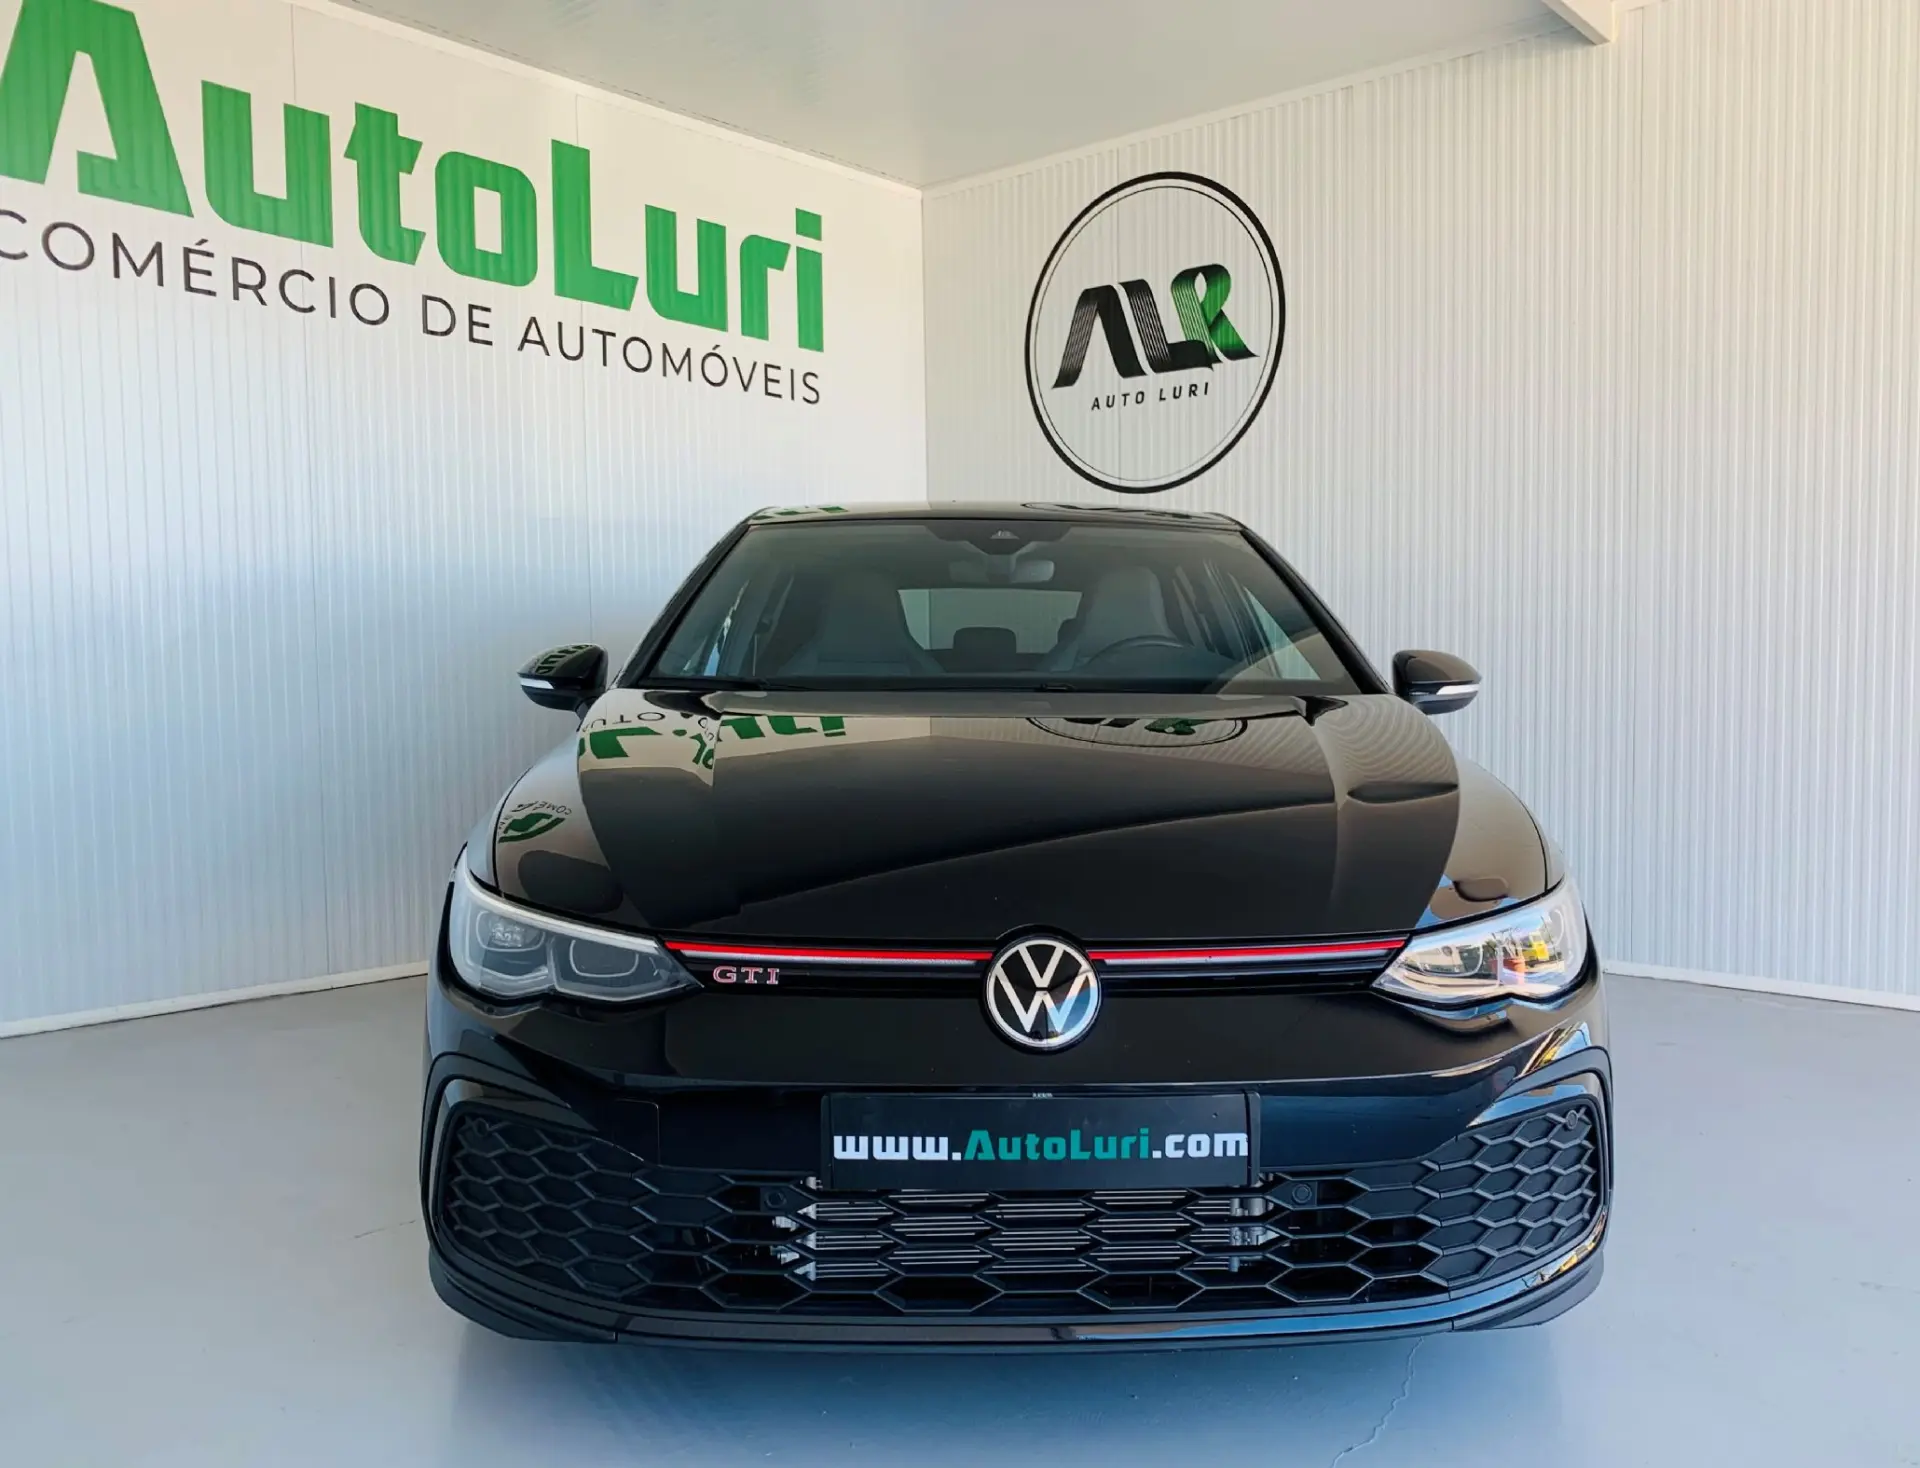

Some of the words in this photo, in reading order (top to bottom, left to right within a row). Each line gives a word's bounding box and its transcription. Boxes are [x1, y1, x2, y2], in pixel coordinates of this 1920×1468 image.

[0, 0, 825, 353] AutoLuri
[422, 295, 494, 347] DE
[518, 316, 822, 406] AUTOMÓVEIS
[1091, 391, 1145, 411] AUTO
[1159, 382, 1209, 402] LURI
[712, 965, 780, 985] GTI
[833, 1127, 1249, 1161] www.AutoLuri.com
